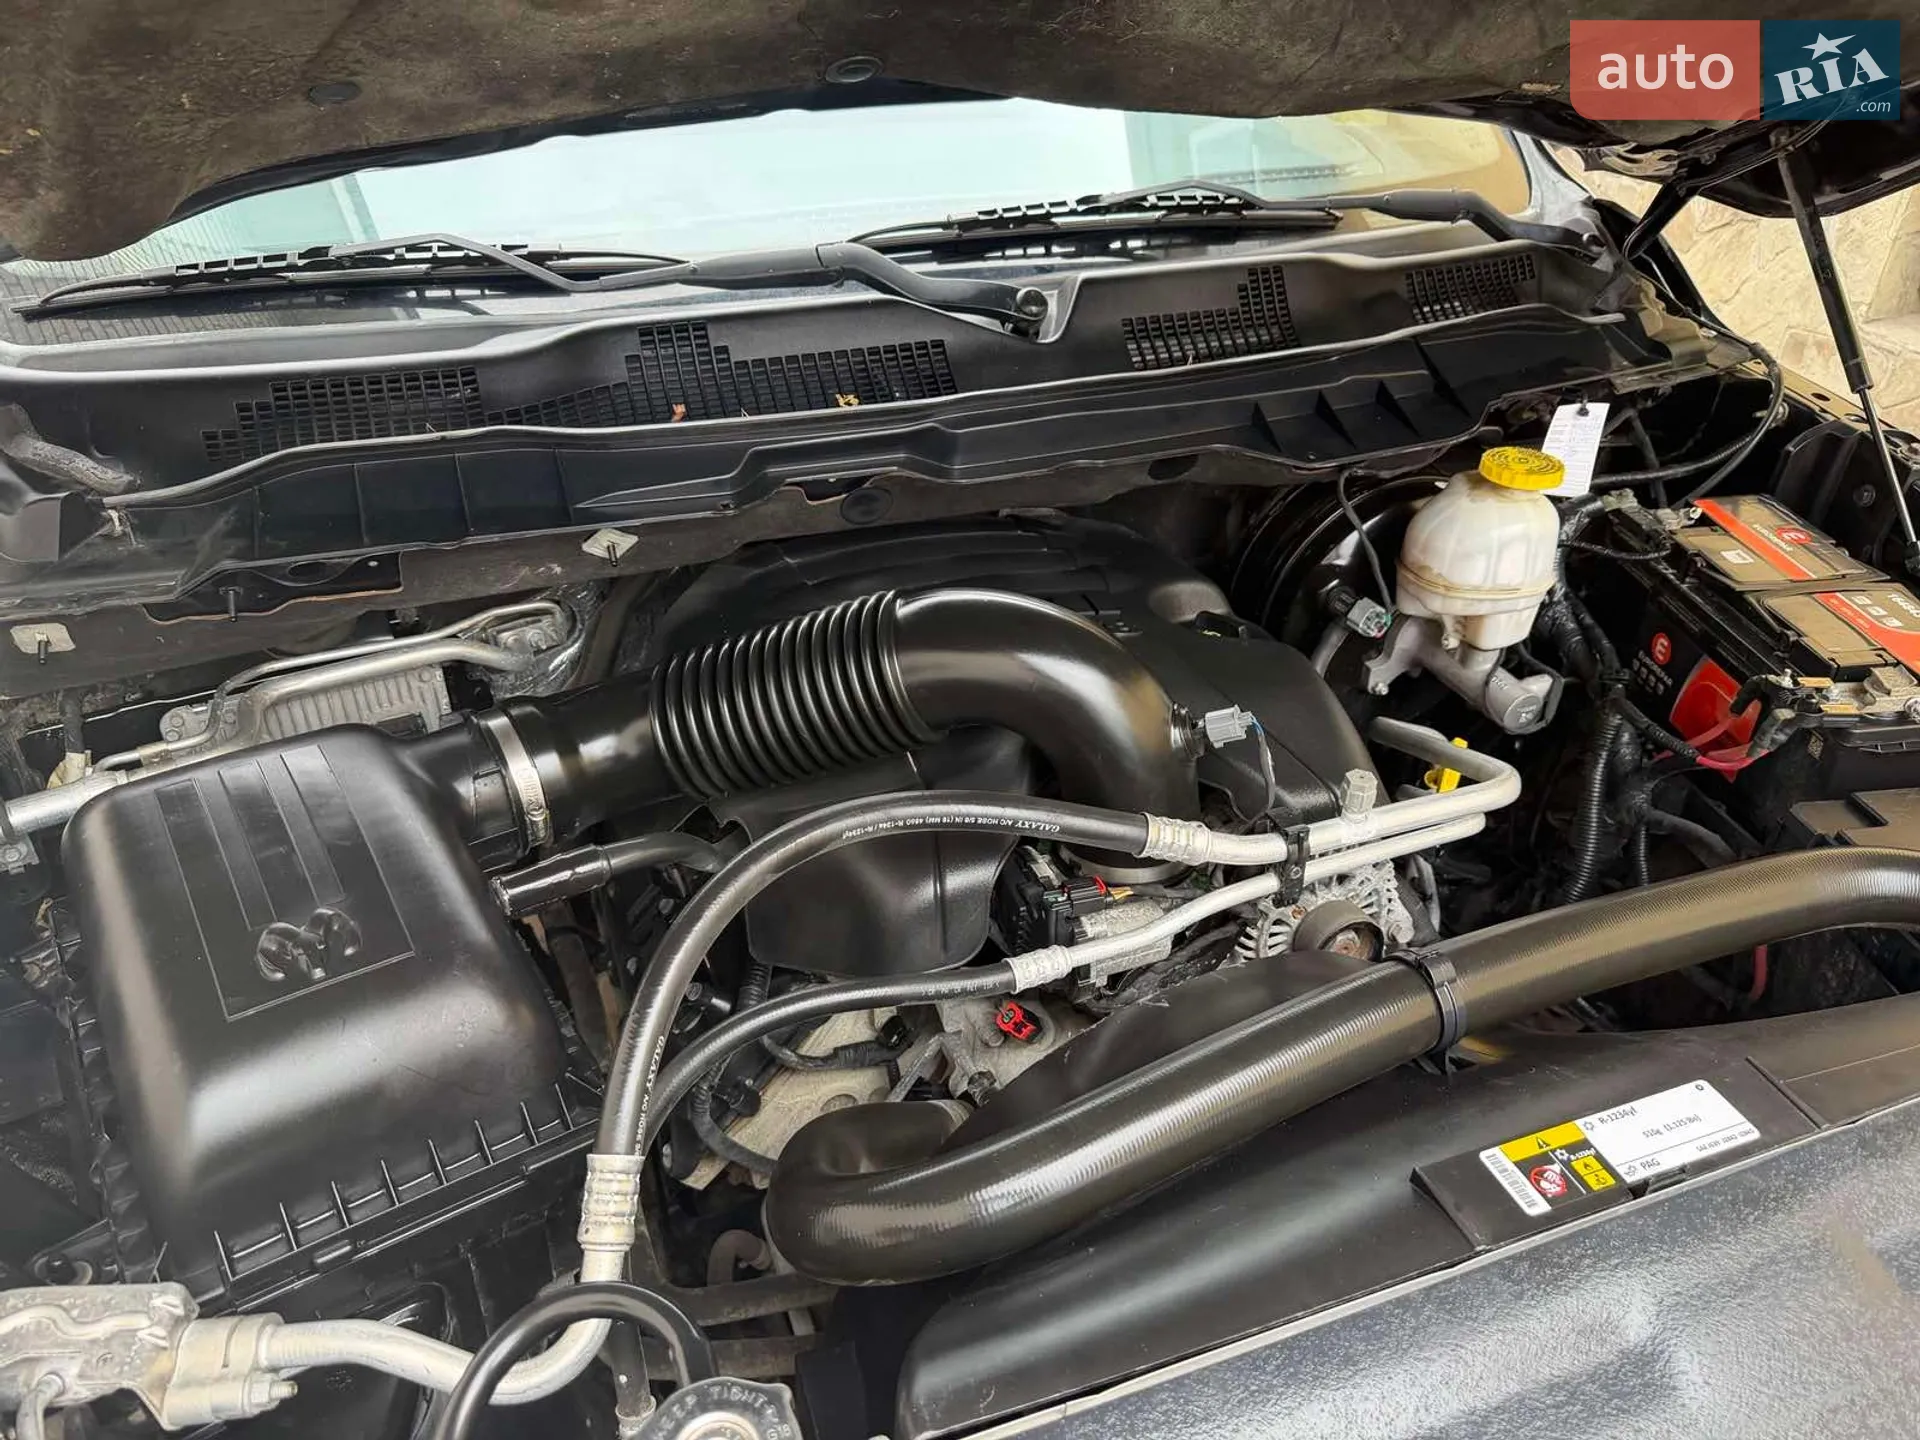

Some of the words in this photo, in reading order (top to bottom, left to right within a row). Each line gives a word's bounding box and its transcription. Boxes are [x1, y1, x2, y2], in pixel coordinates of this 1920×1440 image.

[977, 817, 999, 826] HOSE
[999, 819, 1014, 827] A/C
[1014, 820, 1060, 833] GALAXY
[646, 1035, 665, 1092] GALAXY
[636, 1113, 646, 1141] HOSE
[1640, 1156, 1661, 1171] PAG
